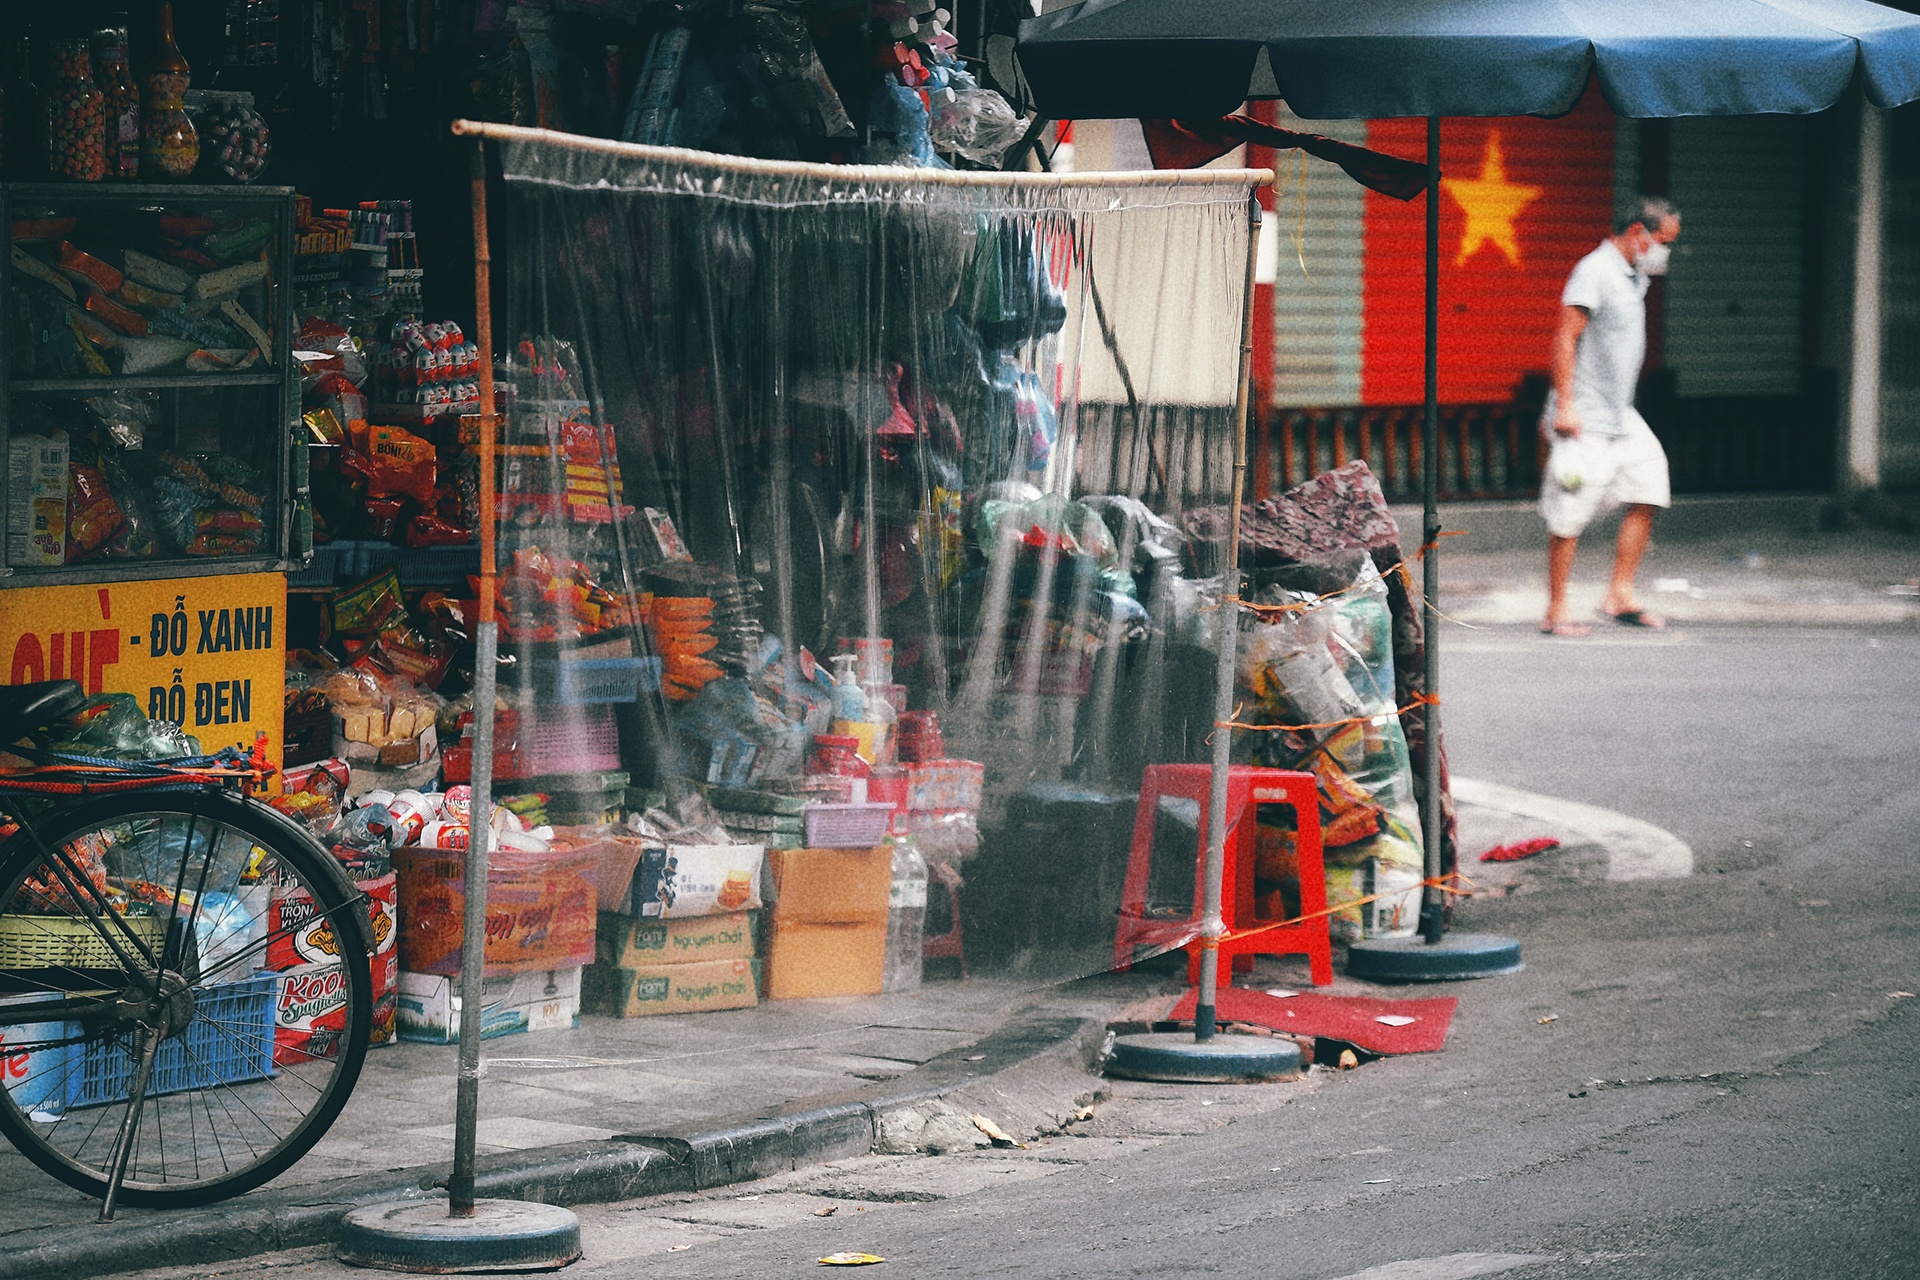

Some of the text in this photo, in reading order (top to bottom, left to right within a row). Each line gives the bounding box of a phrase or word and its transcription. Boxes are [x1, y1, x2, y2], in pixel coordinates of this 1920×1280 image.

[150, 594, 188, 658] ĐỖ
[197, 605, 273, 654] XANH
[148, 667, 251, 727] ĐỖ ĐEN
